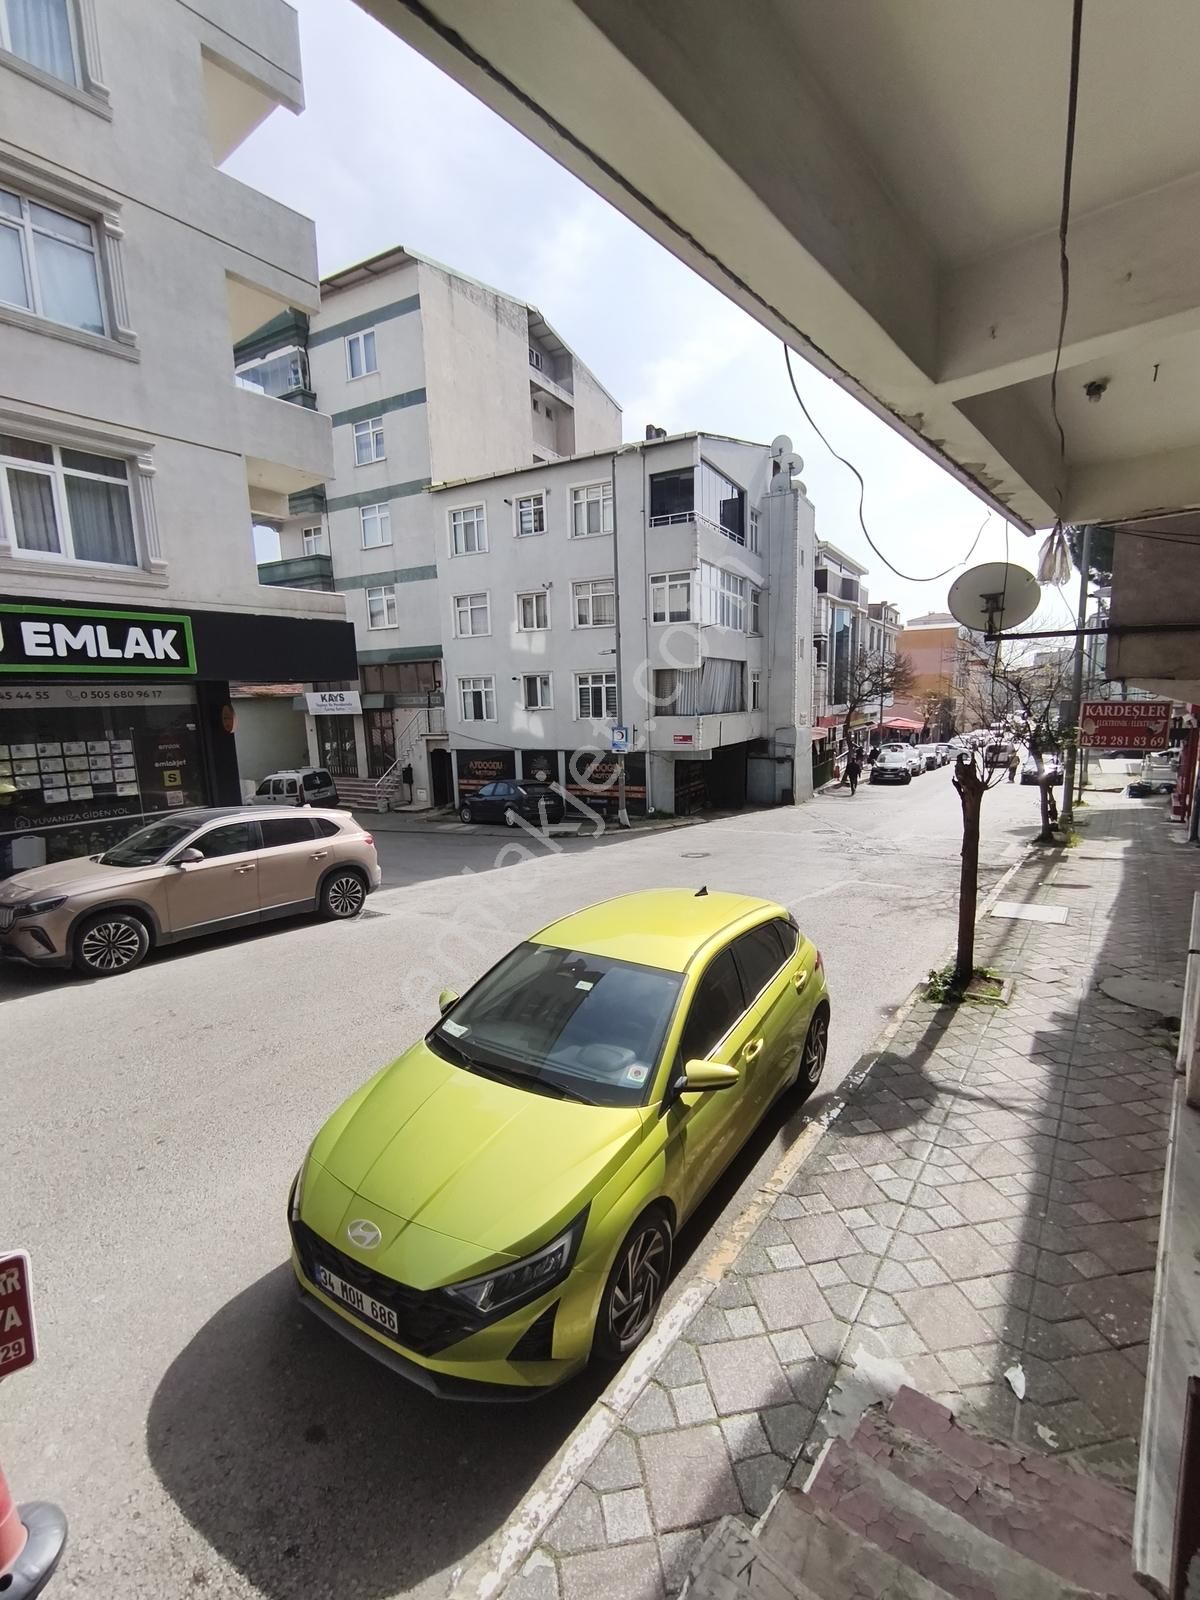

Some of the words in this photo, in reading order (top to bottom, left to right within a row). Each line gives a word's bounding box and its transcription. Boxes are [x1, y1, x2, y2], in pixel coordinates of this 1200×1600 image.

[20, 621, 181, 660] EMLAK
[16, 691, 32, 699] 44
[35, 690, 50, 699] 55
[91, 690, 111, 699] 505
[113, 690, 133, 698] 680
[136, 690, 150, 698] 96
[152, 690, 163, 698] 17
[320, 693, 345, 702] KAYS
[1086, 705, 1166, 719] KARDEŞLER
[1081, 735, 1107, 746] 0532
[1110, 736, 1129, 746] 281
[1133, 737, 1146, 746] 83
[1149, 737, 1164, 746] 69
[154, 759, 186, 768] emlakjet
[167, 773, 177, 783] S
[32, 814, 82, 825] YUVANIZA
[82, 809, 112, 820] GİDEN
[112, 807, 130, 817] YOL
[320, 1268, 335, 1291] 34
[341, 1281, 364, 1311] MOH
[370, 1301, 396, 1330] 686
